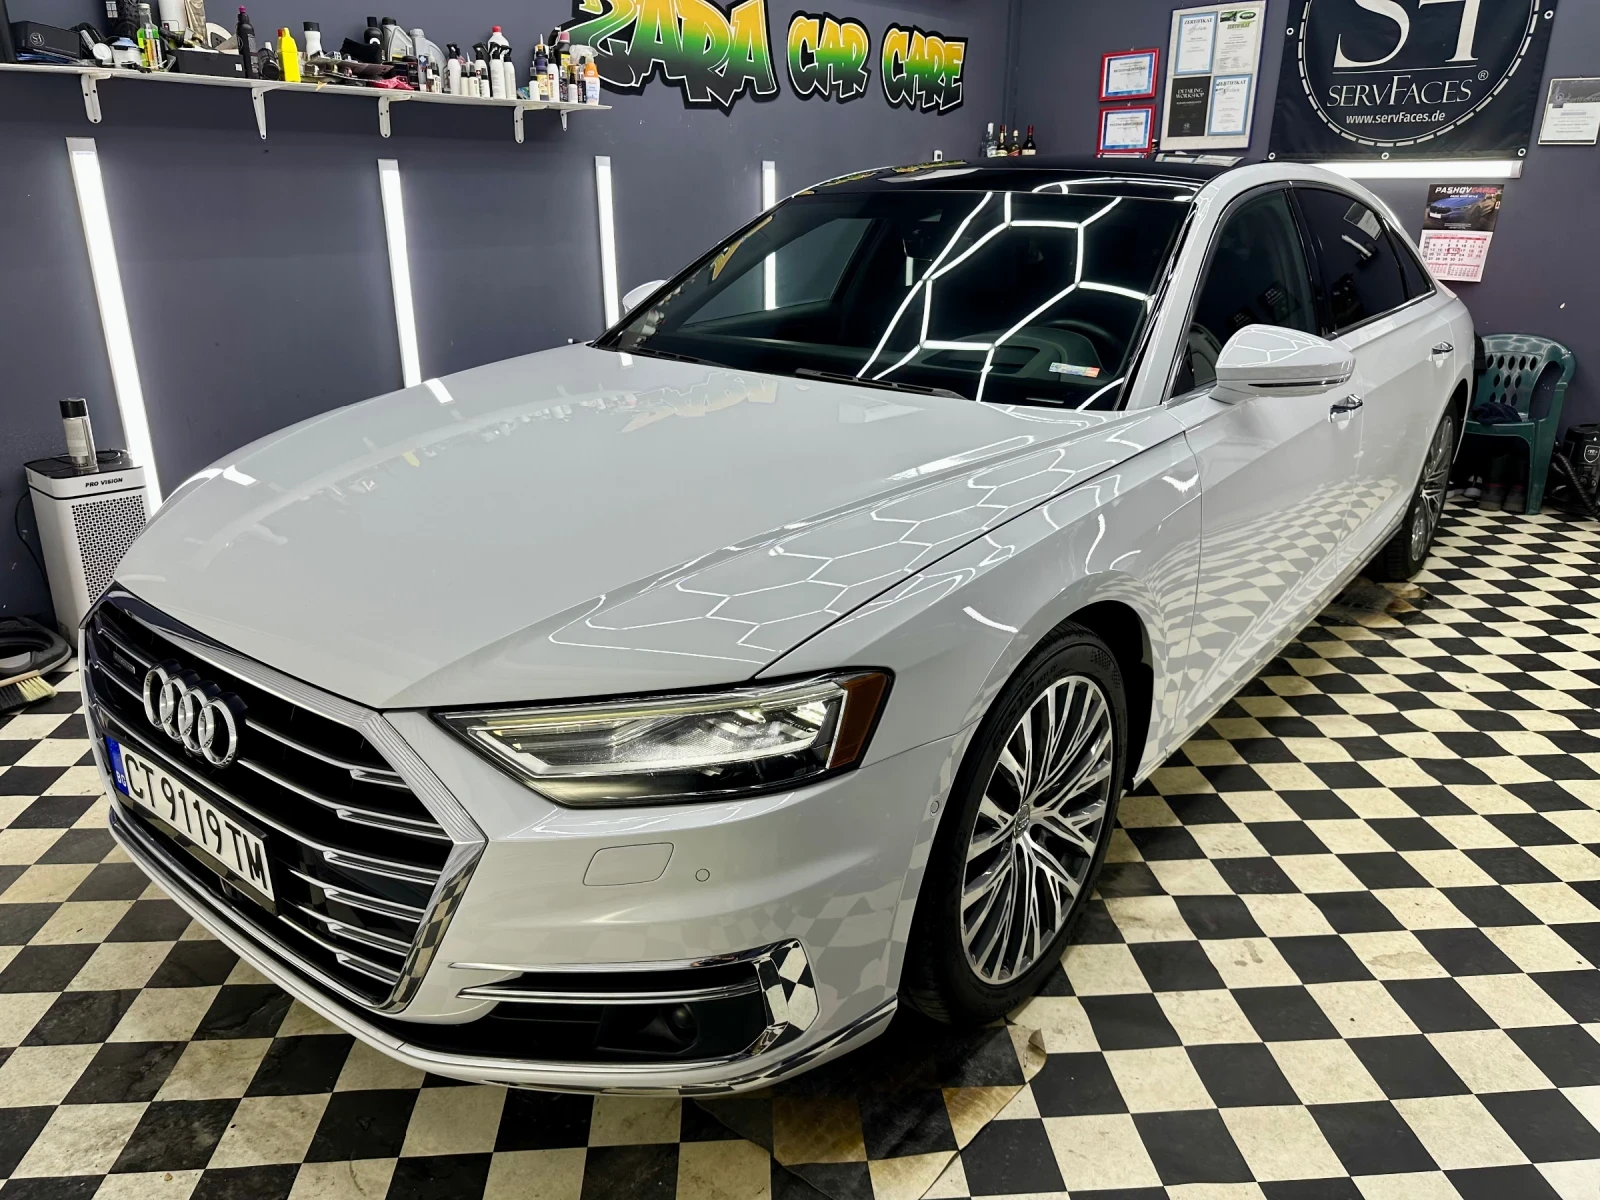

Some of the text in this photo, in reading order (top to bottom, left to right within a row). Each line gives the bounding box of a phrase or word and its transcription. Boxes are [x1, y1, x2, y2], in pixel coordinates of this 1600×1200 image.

[787, 15, 871, 99] CAR
[883, 27, 965, 111] CARE
[1345, 110, 1446, 125] www.servFaces.de
[100, 478, 123, 486] VISION
[115, 769, 127, 788] BG
[123, 754, 269, 891] CT 9119 TM
